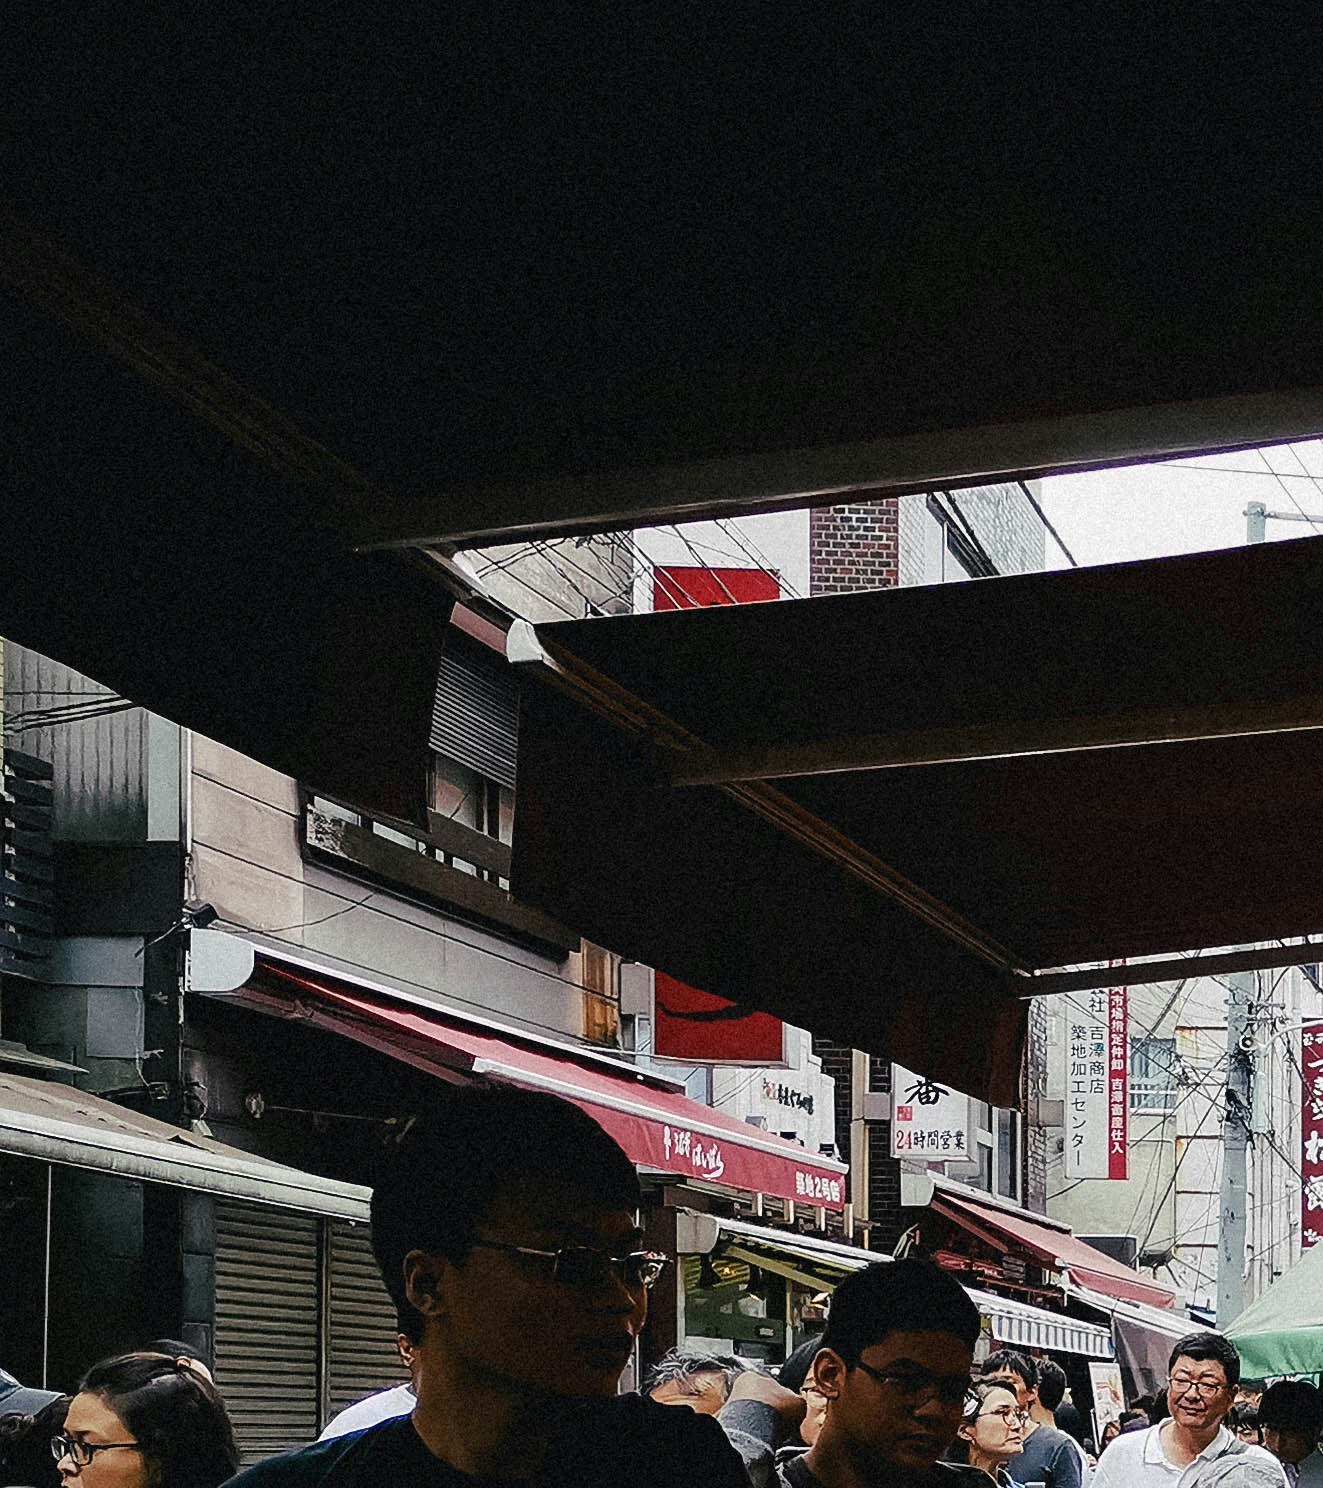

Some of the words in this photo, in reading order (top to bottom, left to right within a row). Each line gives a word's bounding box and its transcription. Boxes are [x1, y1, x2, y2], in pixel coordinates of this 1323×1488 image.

[1070, 1025, 1087, 1167] 築地加工センター
[896, 1129, 965, 1150] 24時間営業
